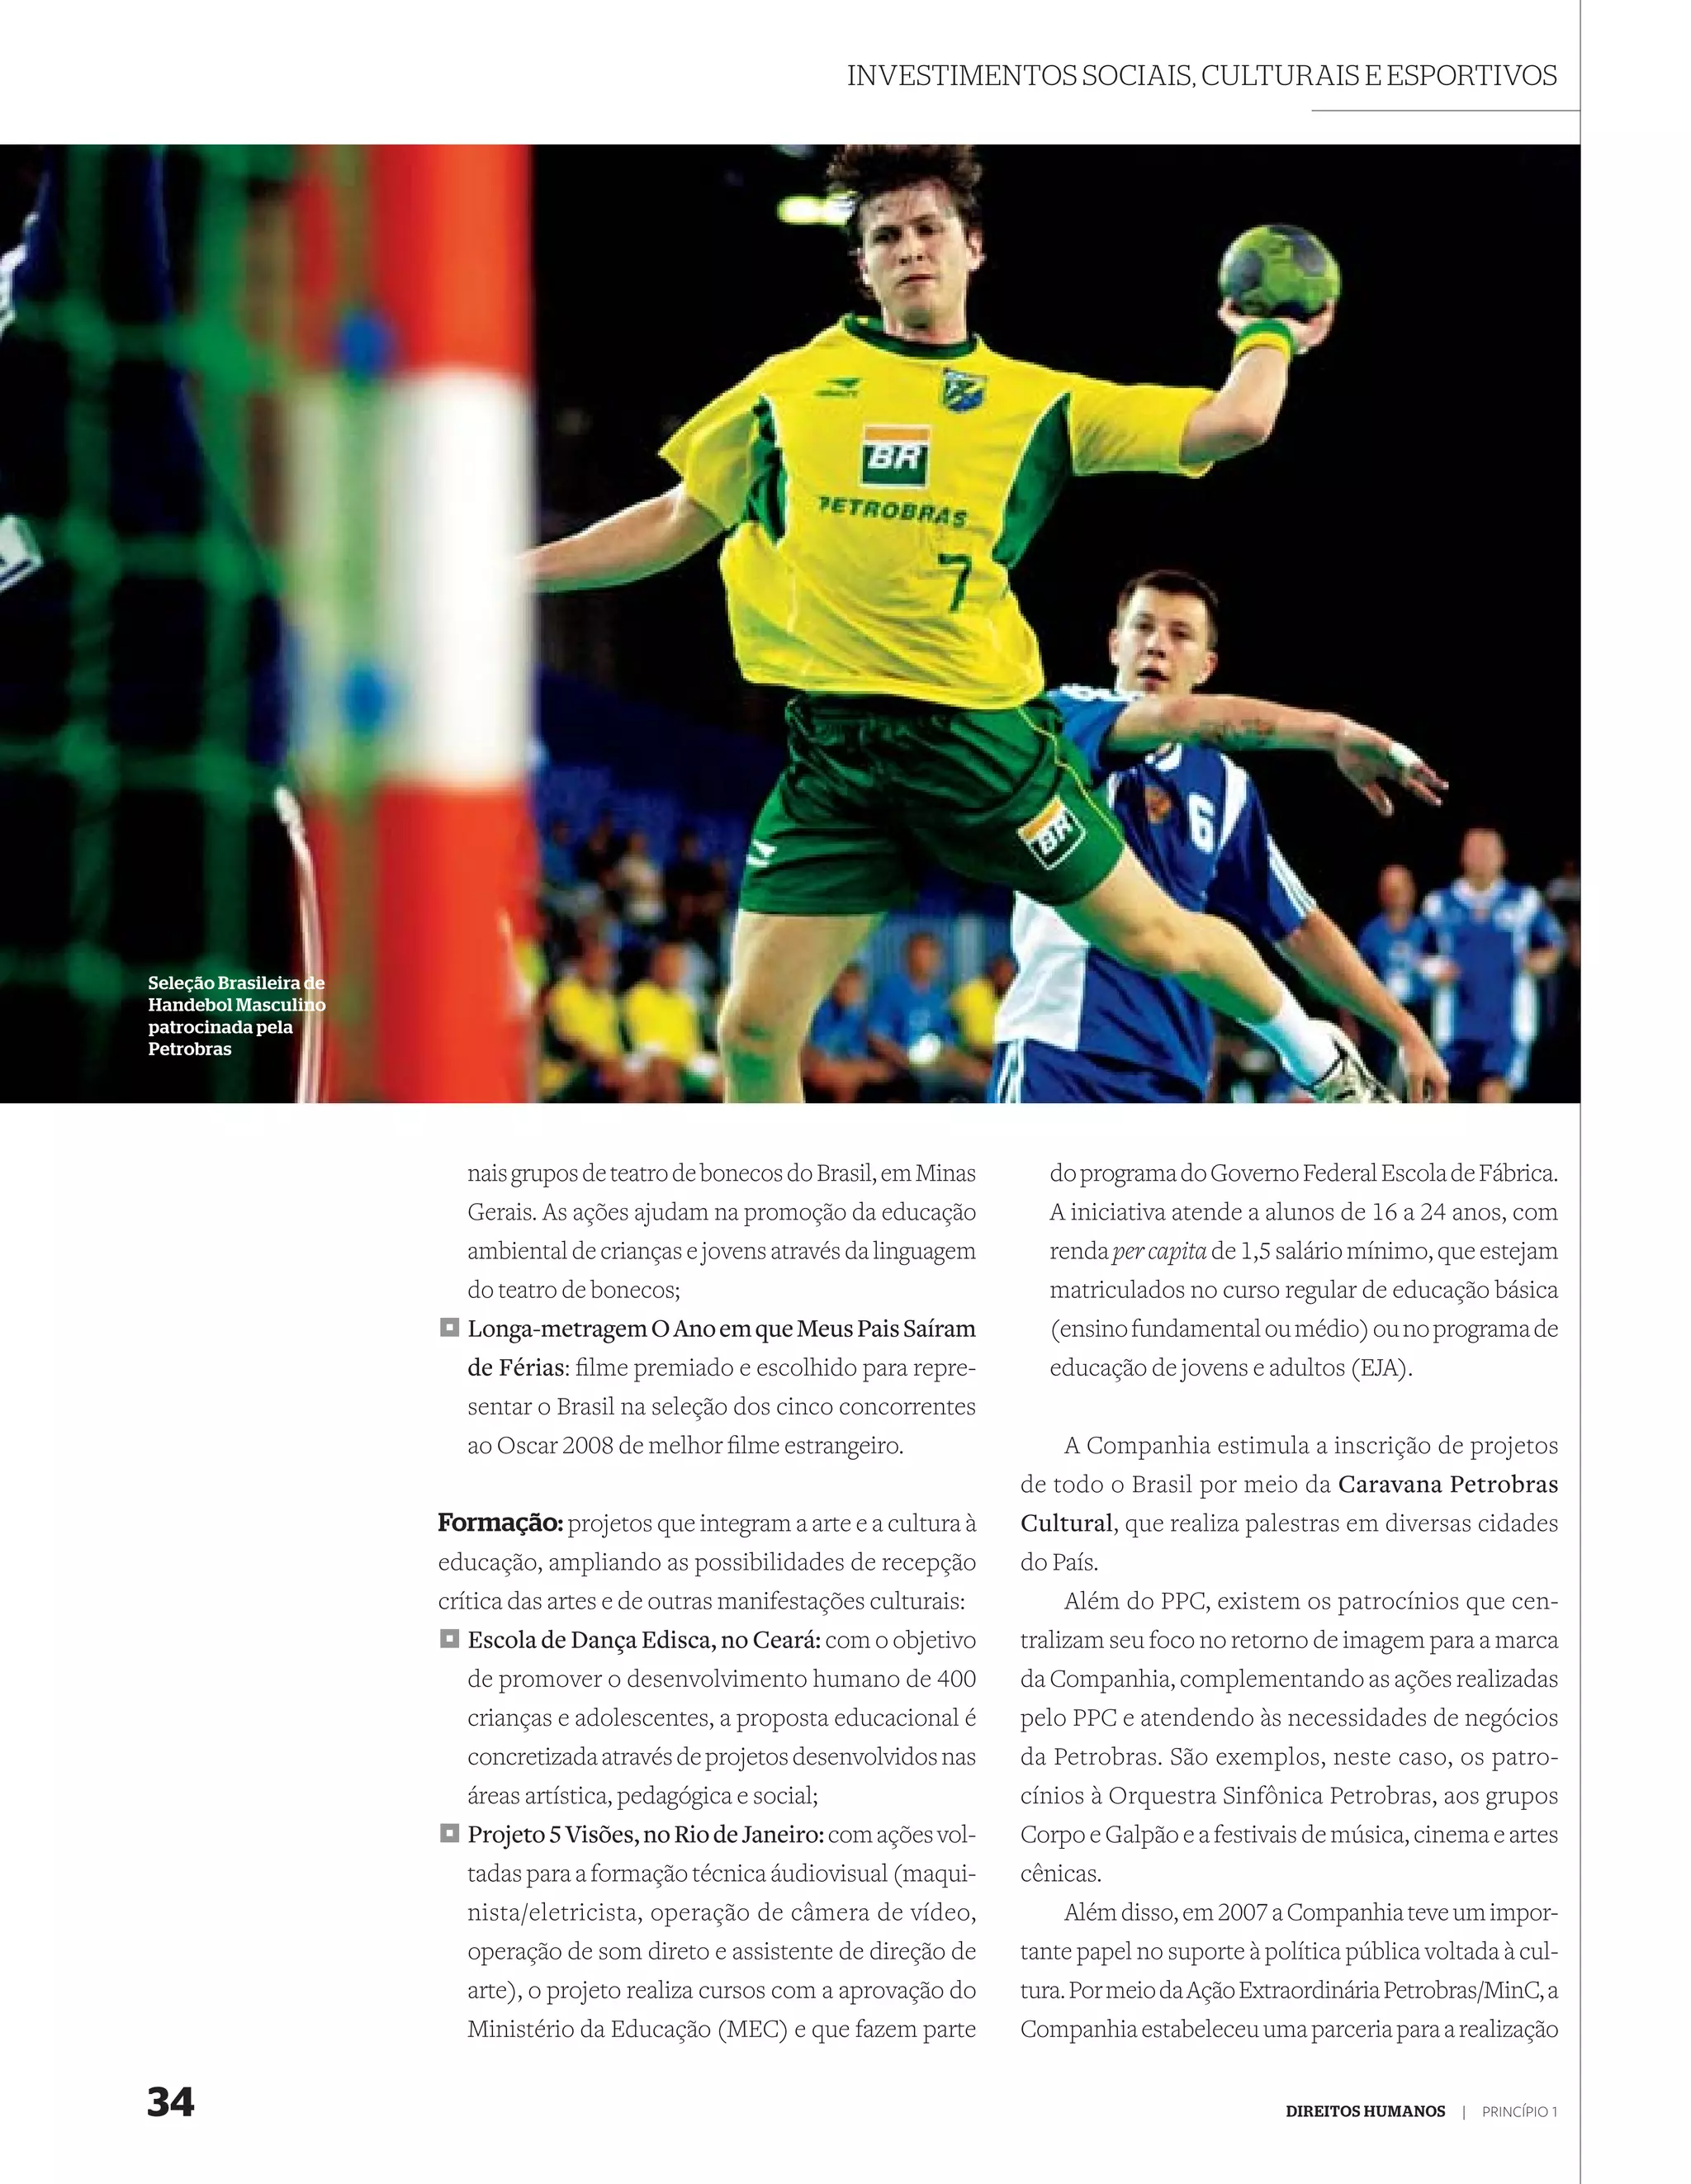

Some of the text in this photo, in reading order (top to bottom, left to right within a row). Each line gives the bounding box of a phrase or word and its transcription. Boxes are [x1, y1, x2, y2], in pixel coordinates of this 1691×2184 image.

[847, 64, 1557, 88] INVESTIMENTOS SOCIAIS, CULTURAIS E ESPORTIVOS
[868, 443, 921, 469] BR
[819, 496, 968, 528] PETROBRAS
[938, 553, 972, 613] 7
[1038, 809, 1073, 855] BR
[1189, 792, 1215, 854] 6
[467, 1162, 976, 1188] nais grupos de teatro de bonecos do Brasil, em Minas
[1050, 1162, 1558, 1188] do programa do Governo Federal Escola de Fábrica.
[1049, 1239, 1559, 1267] renda per capita de 1,5 salário mínimo, que estejam
[468, 1318, 977, 1344] Longa-metragem O Ano em que Meus Pais Saíram
[1021, 1473, 1559, 1499] de todo o Brasil por meio da Caravana Petrobras
[438, 1512, 978, 1539] Formação: projetos que integram a arte e a cultura à
[1021, 1512, 1558, 1538] Cultural, que realiza palestras em diversas cidades
[1063, 1590, 1559, 1616] Além do PPC, existem os patrocínios que cen-
[468, 1629, 977, 1656] Escola de Dança Edisca, no Ceará: com o objetivo
[1020, 1707, 1558, 1733] pelo PPC e atendendo às necessidades de negócios
[1021, 1784, 1558, 1811] cínios à Orquestra Sinfônica Petrobras, aos grupos
[468, 1823, 976, 1850] Projeto 5 Visões, no Rio de Janeiro: com ações vol-
[1063, 1902, 1559, 1927] Além disso, em 2007 a Companhia teve um impor-
[467, 2018, 976, 2044] Ministério da Educação (MEC) e que fazem parte
[1021, 2018, 1559, 2044] Companhia estabeleceu uma parceria para a realização
[147, 2086, 195, 2117] 34
[1286, 2105, 1446, 2118] DIREITOS HUMANOS
[1482, 2102, 1557, 2118] PRINCÍPIO 1
